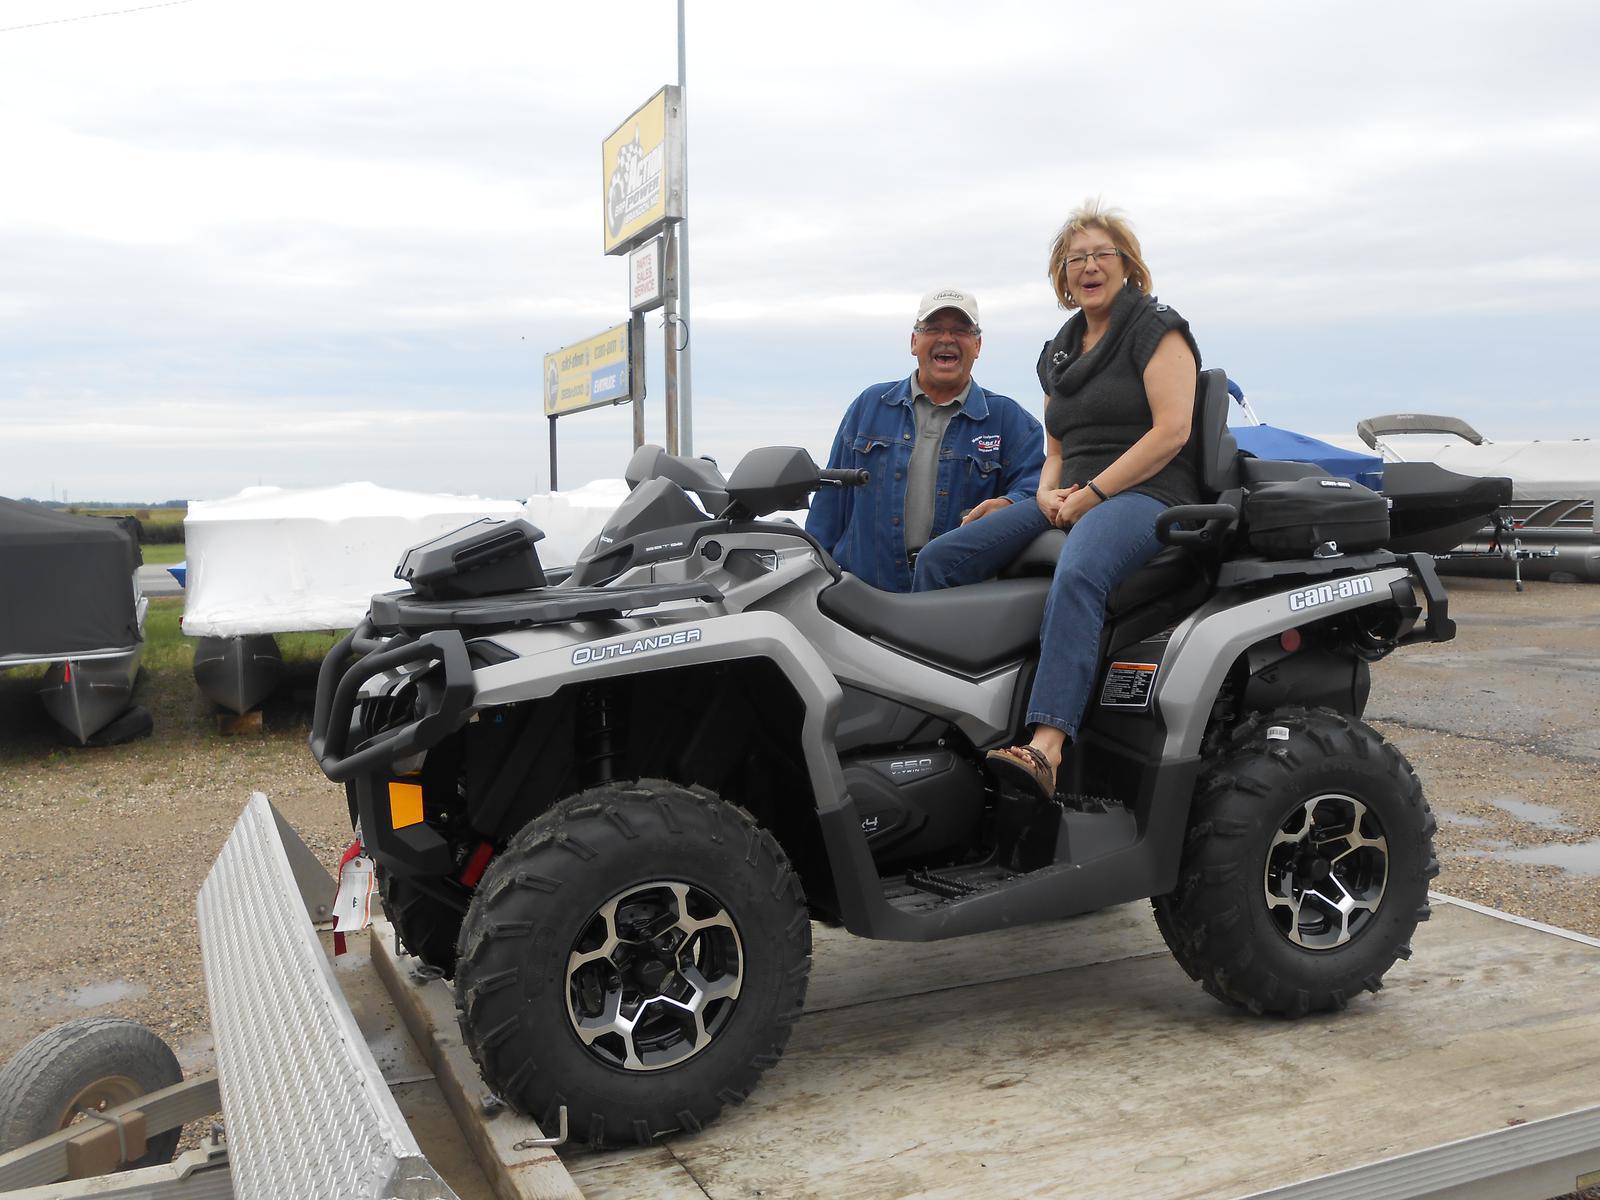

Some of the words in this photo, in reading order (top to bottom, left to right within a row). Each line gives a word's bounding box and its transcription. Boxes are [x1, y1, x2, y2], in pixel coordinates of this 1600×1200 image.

[627, 176, 659, 208] POWER
[634, 278, 655, 299] SERVICE
[636, 266, 653, 285] SALES
[1289, 576, 1373, 611] can-am
[572, 628, 701, 665] OUTLANDER
[890, 758, 932, 770] 650
